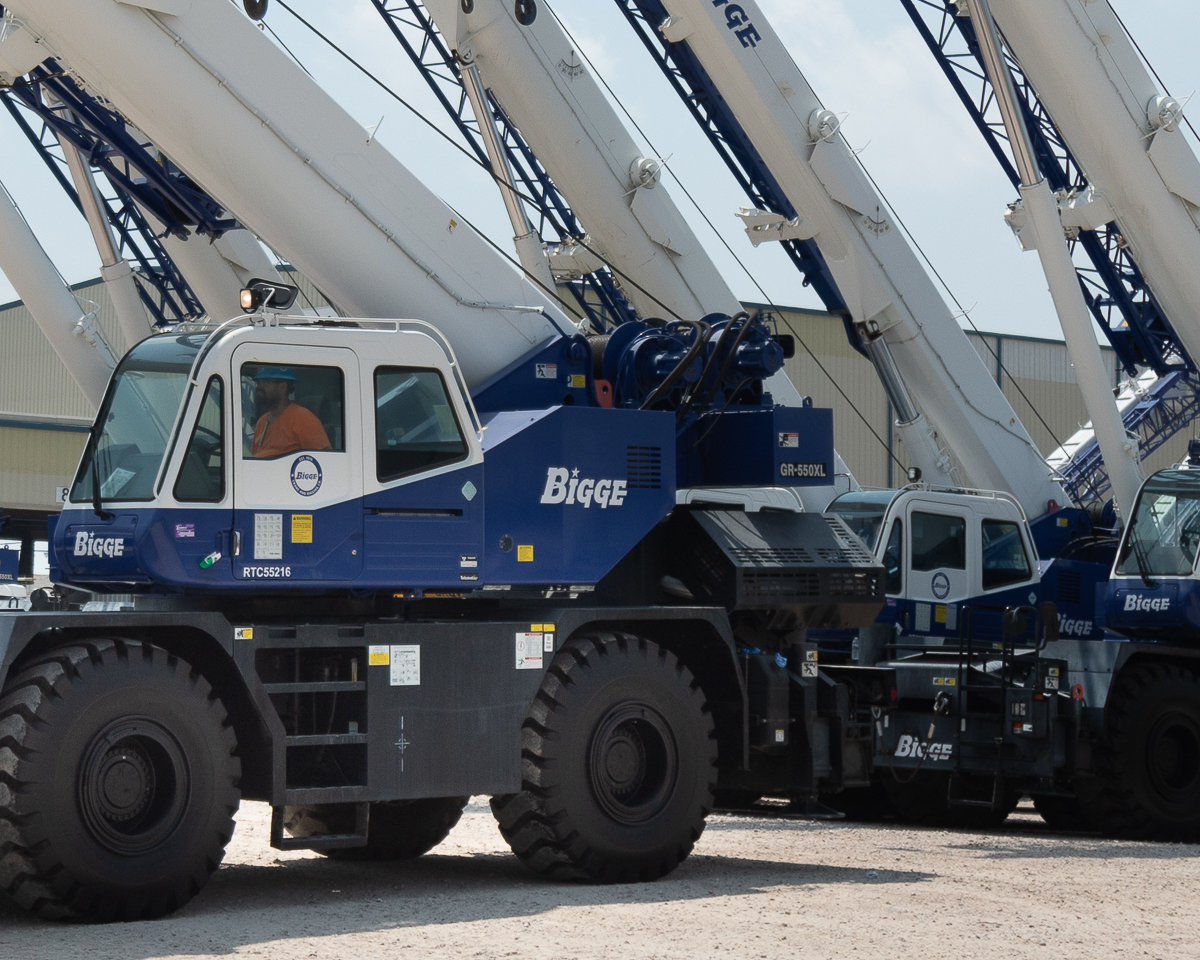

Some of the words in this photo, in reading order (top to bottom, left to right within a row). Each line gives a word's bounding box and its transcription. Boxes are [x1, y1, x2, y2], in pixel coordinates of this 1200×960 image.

[780, 463, 826, 477] GR-550XL
[243, 566, 292, 578] RTC55216
[1057, 612, 1093, 636] IGGE
